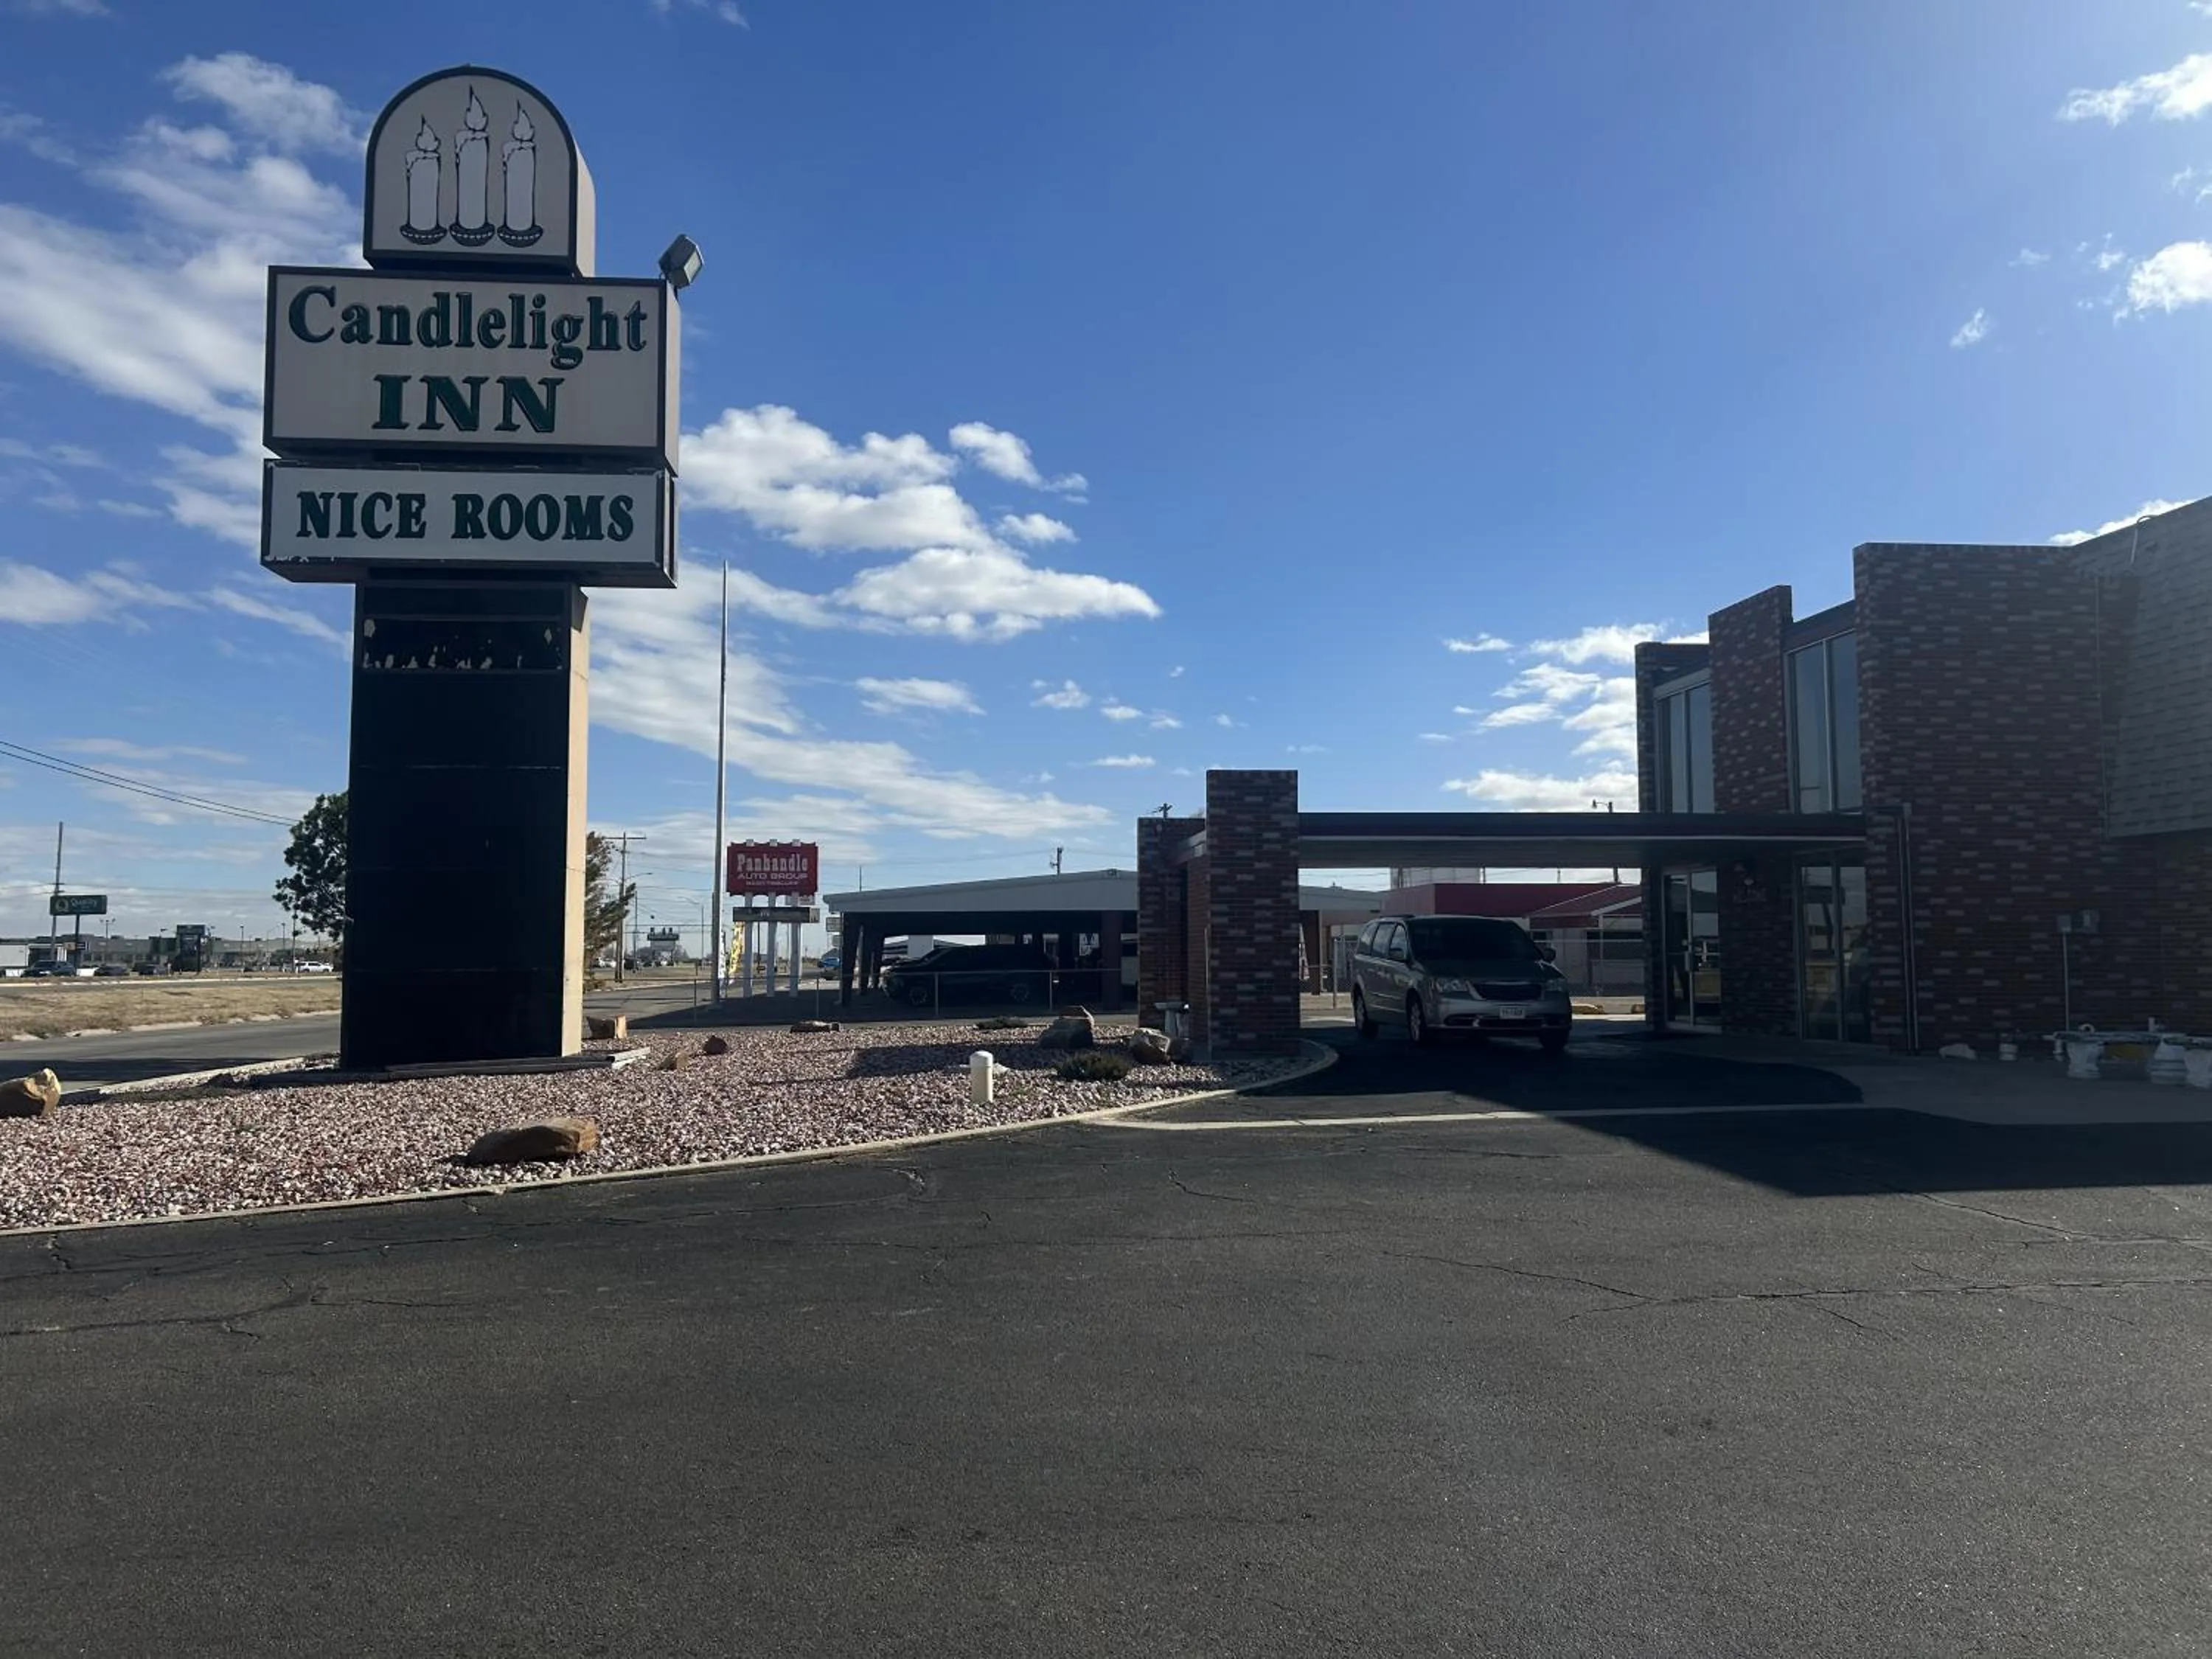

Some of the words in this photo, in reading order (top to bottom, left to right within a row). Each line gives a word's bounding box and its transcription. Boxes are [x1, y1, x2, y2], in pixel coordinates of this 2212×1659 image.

[288, 285, 647, 369] Candlelight
[371, 374, 565, 433] INN
[296, 491, 427, 539] NICE
[451, 493, 634, 542] ROOMS
[737, 853, 809, 872] Panhandle
